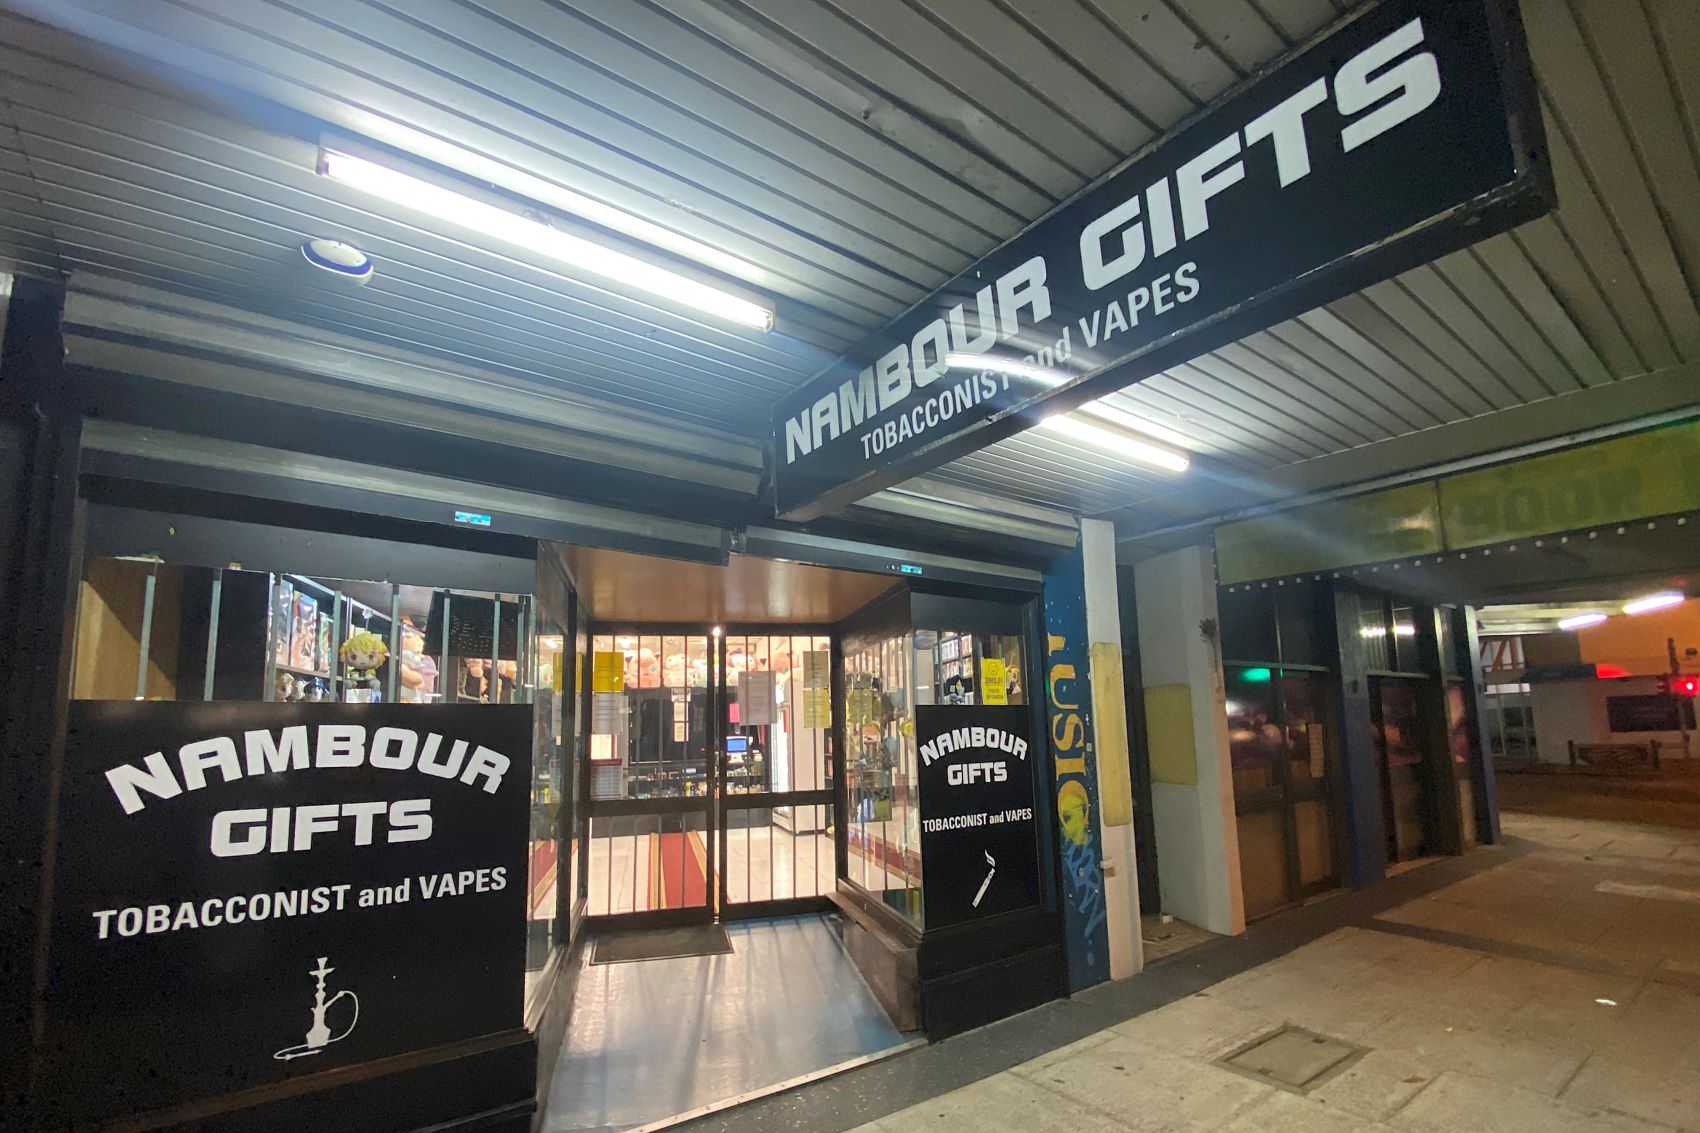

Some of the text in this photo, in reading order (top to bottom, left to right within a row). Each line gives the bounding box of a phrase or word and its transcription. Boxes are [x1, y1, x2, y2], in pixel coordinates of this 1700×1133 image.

[785, 17, 1441, 465] NAMBOUR GIFTS
[861, 368, 1010, 460] TOBACCONIST
[1079, 261, 1200, 348] VAPES
[105, 725, 510, 815] NAMBOUR
[919, 727, 1028, 767] NAMBOUR
[947, 761, 1008, 786] GIFTS
[211, 799, 433, 858] GIFTS
[922, 807, 1032, 833] TOBACCONIST and VAPES
[92, 866, 507, 939] TOBACCONIST and VAPES
